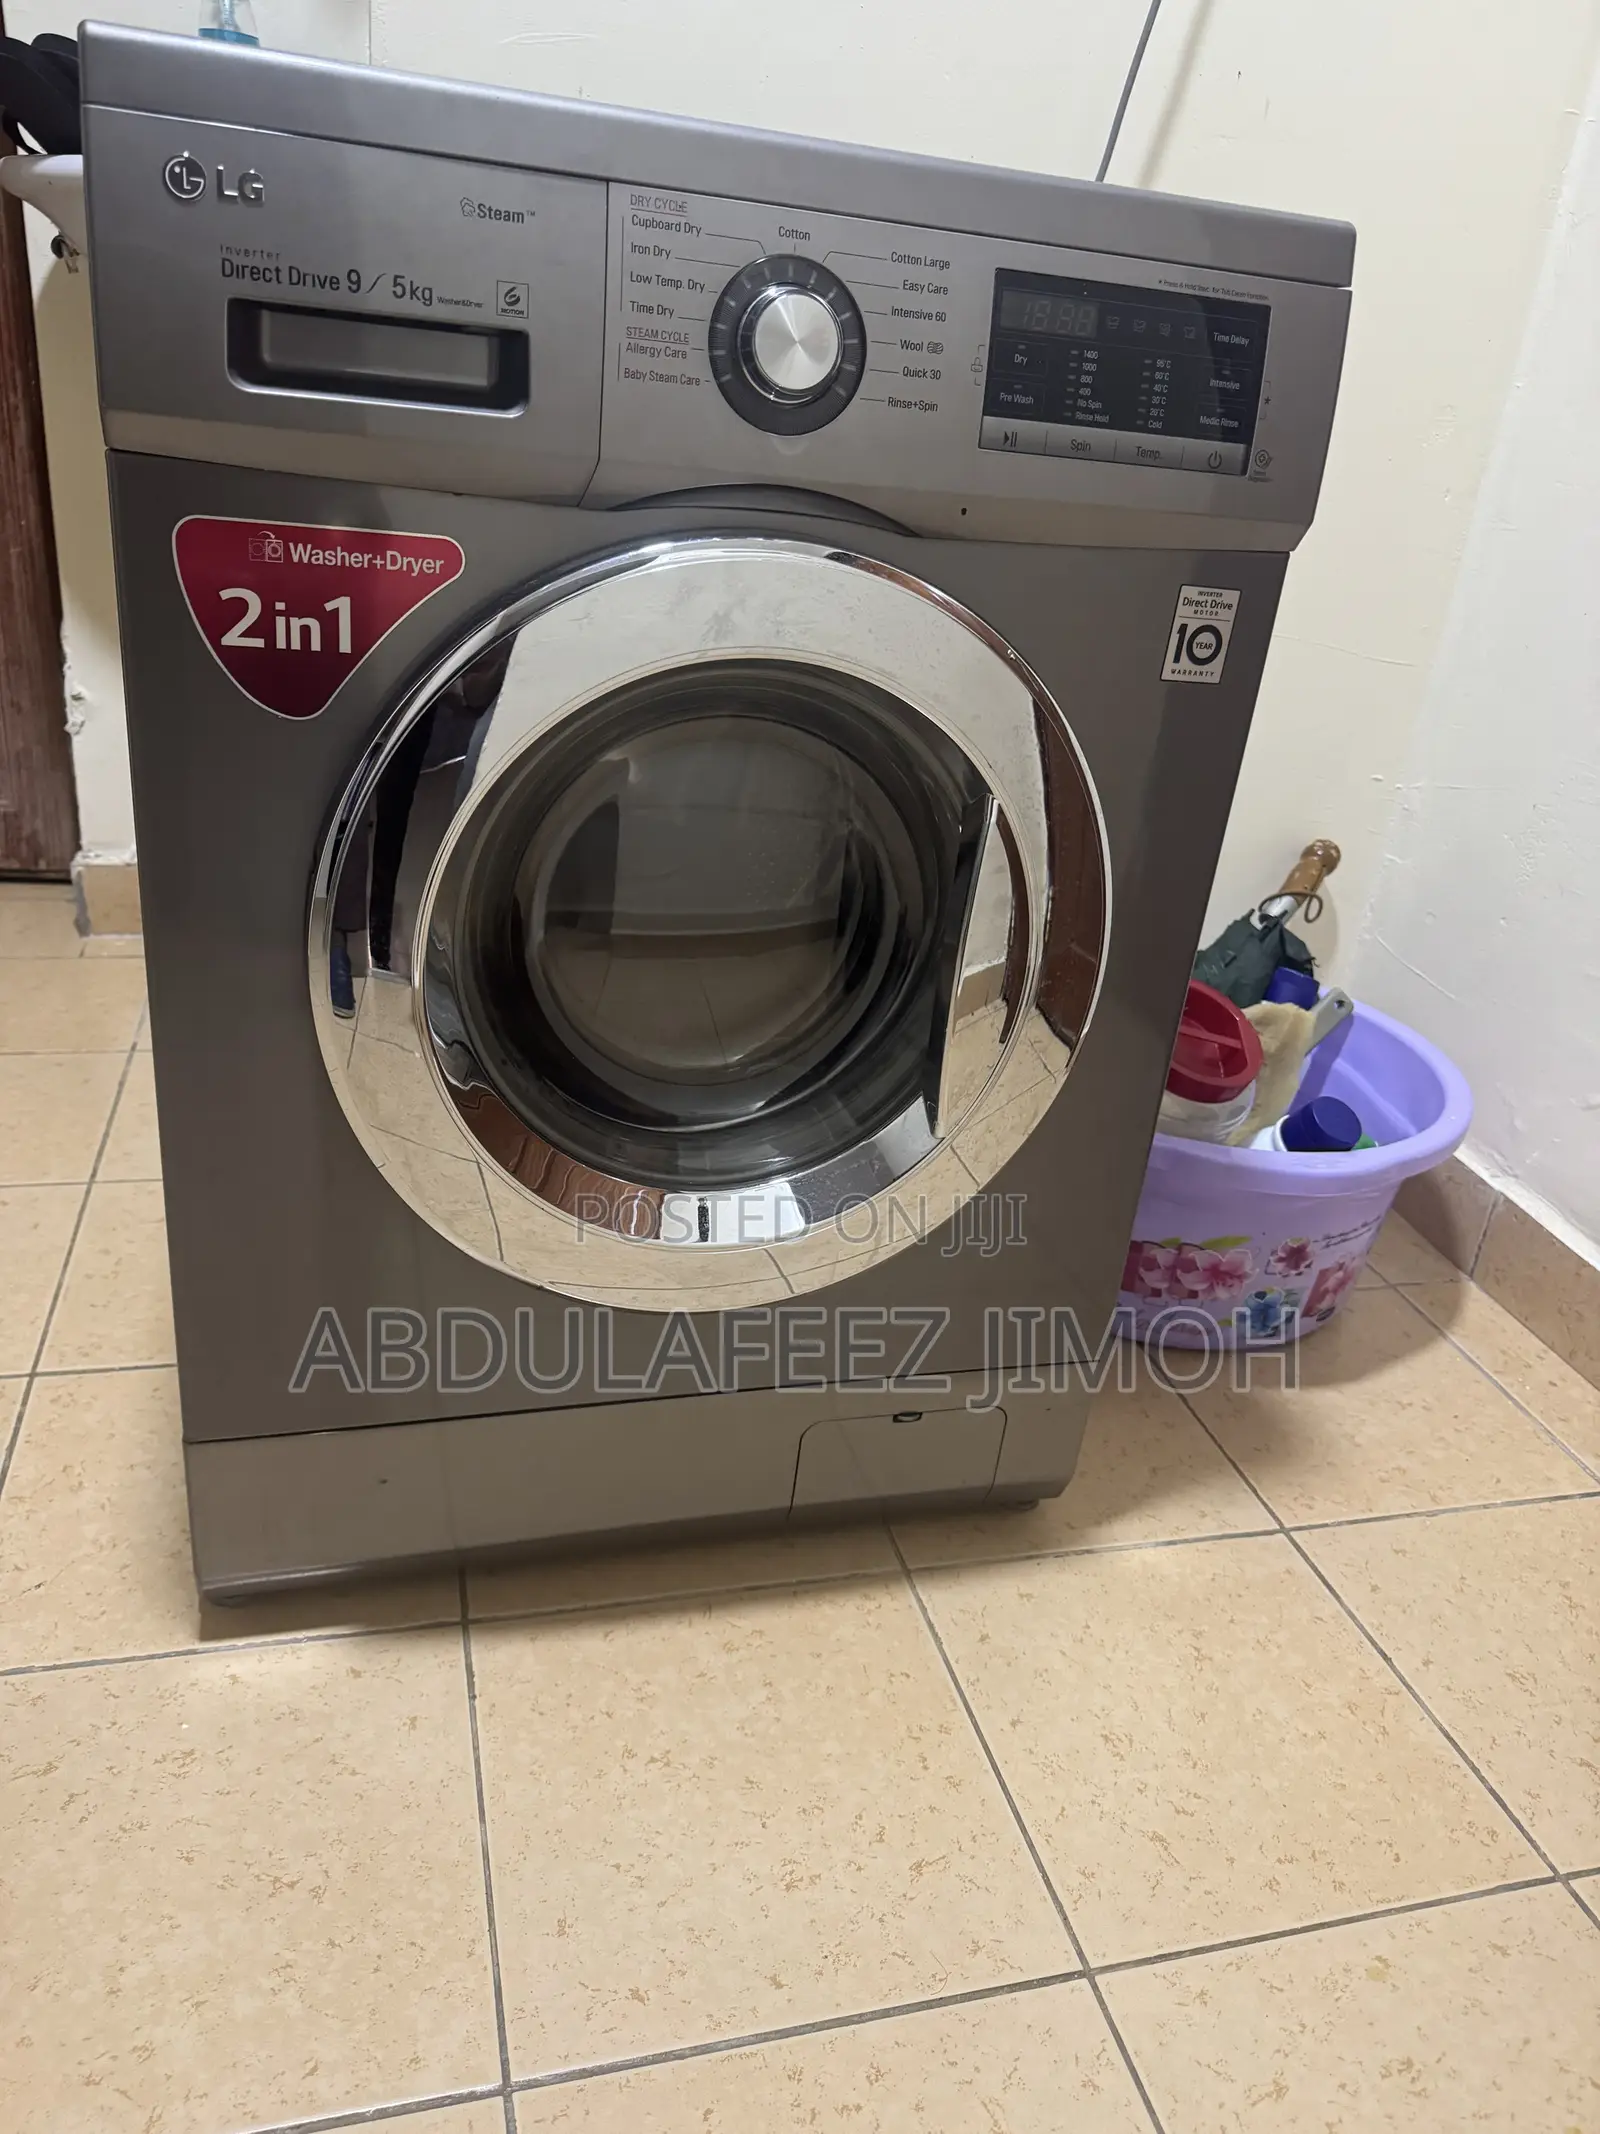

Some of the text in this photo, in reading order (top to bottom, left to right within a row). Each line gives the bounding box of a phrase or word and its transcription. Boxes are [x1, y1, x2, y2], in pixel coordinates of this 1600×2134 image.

[216, 165, 265, 206] LG
[630, 193, 688, 214] DRY CYCLE
[631, 214, 702, 238] Cupboard Dry
[778, 225, 811, 242] Cotton
[219, 244, 281, 261] Inverter
[630, 241, 672, 260] Iron Dry
[890, 251, 951, 272] Cotton Large
[221, 257, 283, 285] Direct
[288, 265, 341, 292] Drive
[346, 268, 362, 294] 9
[629, 270, 706, 294] Low Temp. Dry
[902, 279, 949, 296] Easy Care
[629, 300, 676, 320] Time Dry
[890, 305, 947, 323] Intensive 60
[625, 326, 690, 343] STEAM CYCLE
[1213, 332, 1250, 347] Time Delay
[625, 342, 688, 360] Allergy Care
[899, 338, 924, 353] Wool
[1013, 353, 1028, 367] Dry
[623, 367, 702, 387] Baby Steam Care
[902, 366, 942, 381] Quick 30
[1209, 378, 1241, 391] Intensive
[887, 396, 939, 413] Rinse+Spin
[1000, 392, 1035, 405] Pre Wash
[1087, 399, 1103, 411] Spin
[1147, 419, 1163, 429] Cold
[1220, 418, 1239, 428] Rinse
[1070, 438, 1091, 452] Spin
[289, 542, 444, 576] Washer+Dryer
[1182, 597, 1233, 611] Direct Drive
[1193, 609, 1219, 617] MOTOR
[1195, 641, 1214, 651] YEAR
[1170, 668, 1215, 678] WARRANTY
